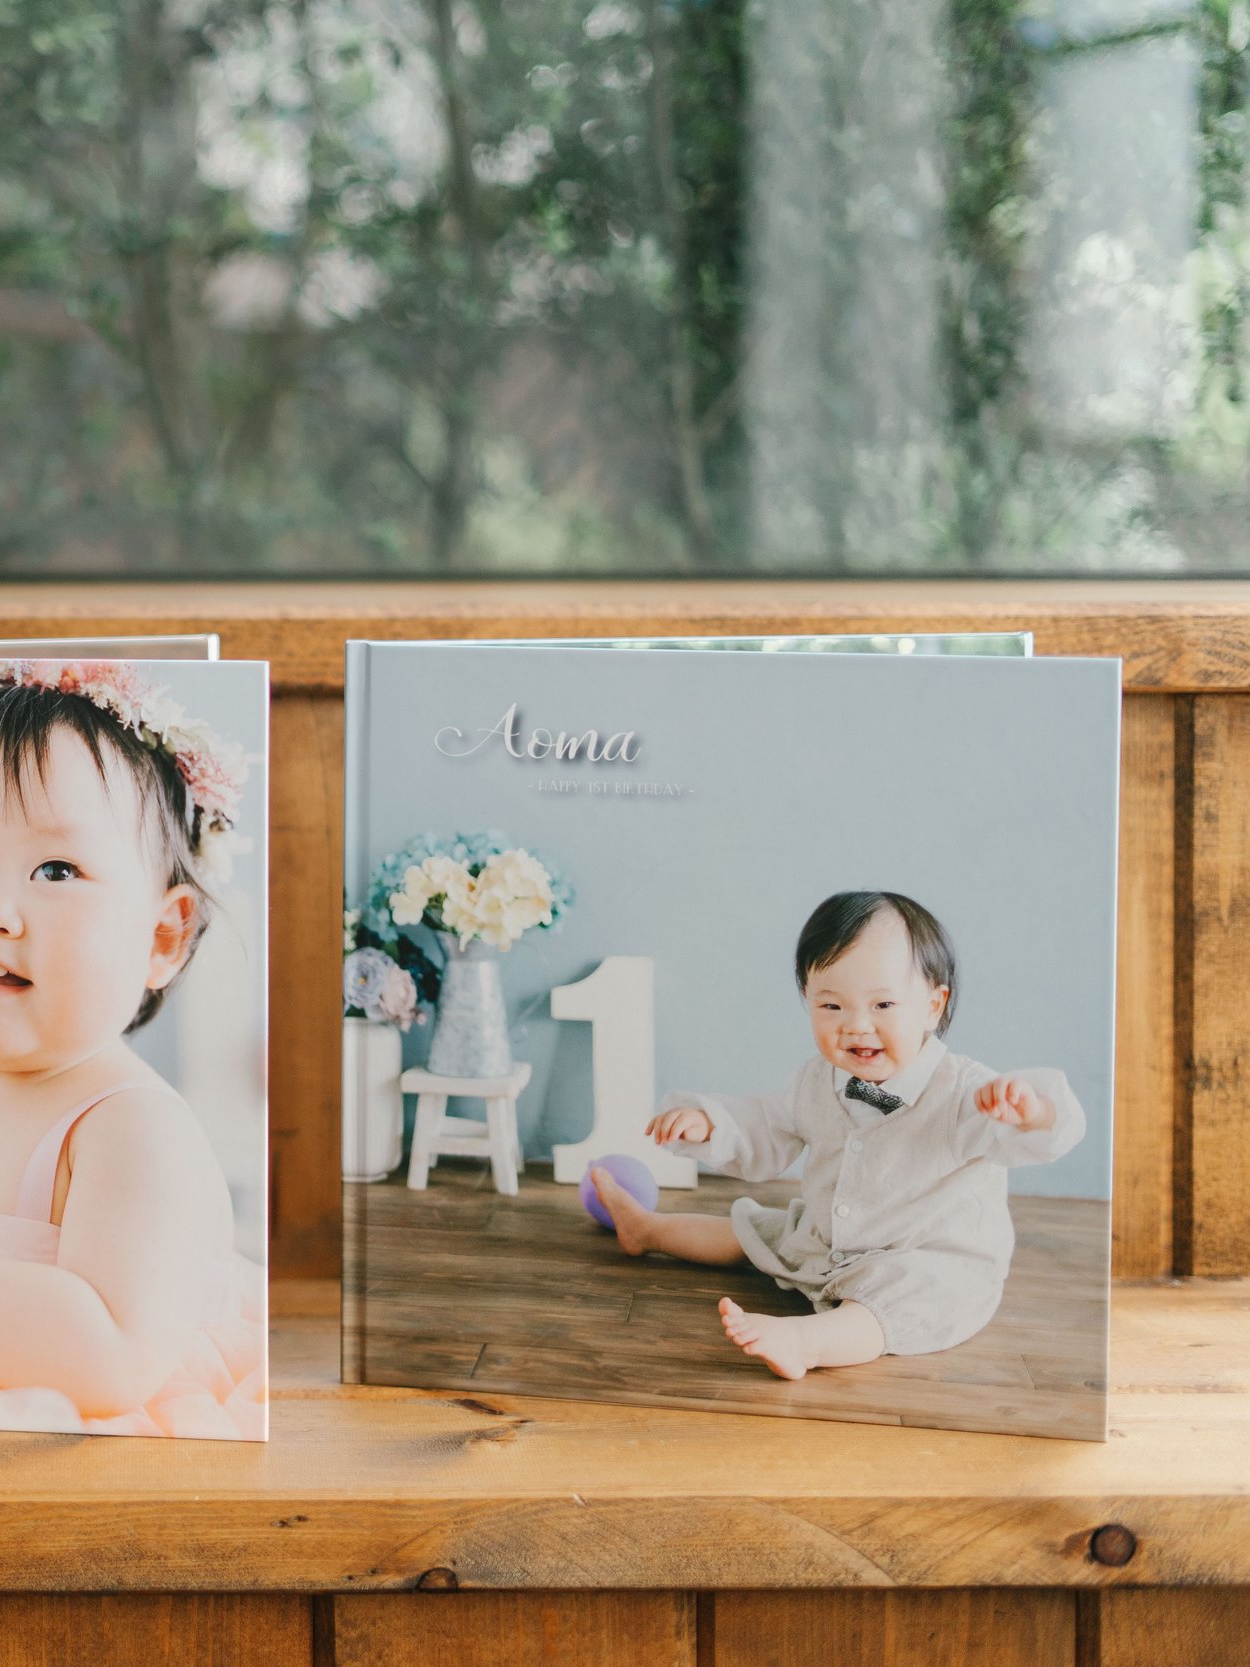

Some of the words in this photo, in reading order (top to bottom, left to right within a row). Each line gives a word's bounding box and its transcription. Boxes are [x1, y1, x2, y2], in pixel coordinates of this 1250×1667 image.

[434, 702, 641, 762] Aoma
[538, 779, 581, 793] HAPPY
[588, 781, 610, 794] 1ST
